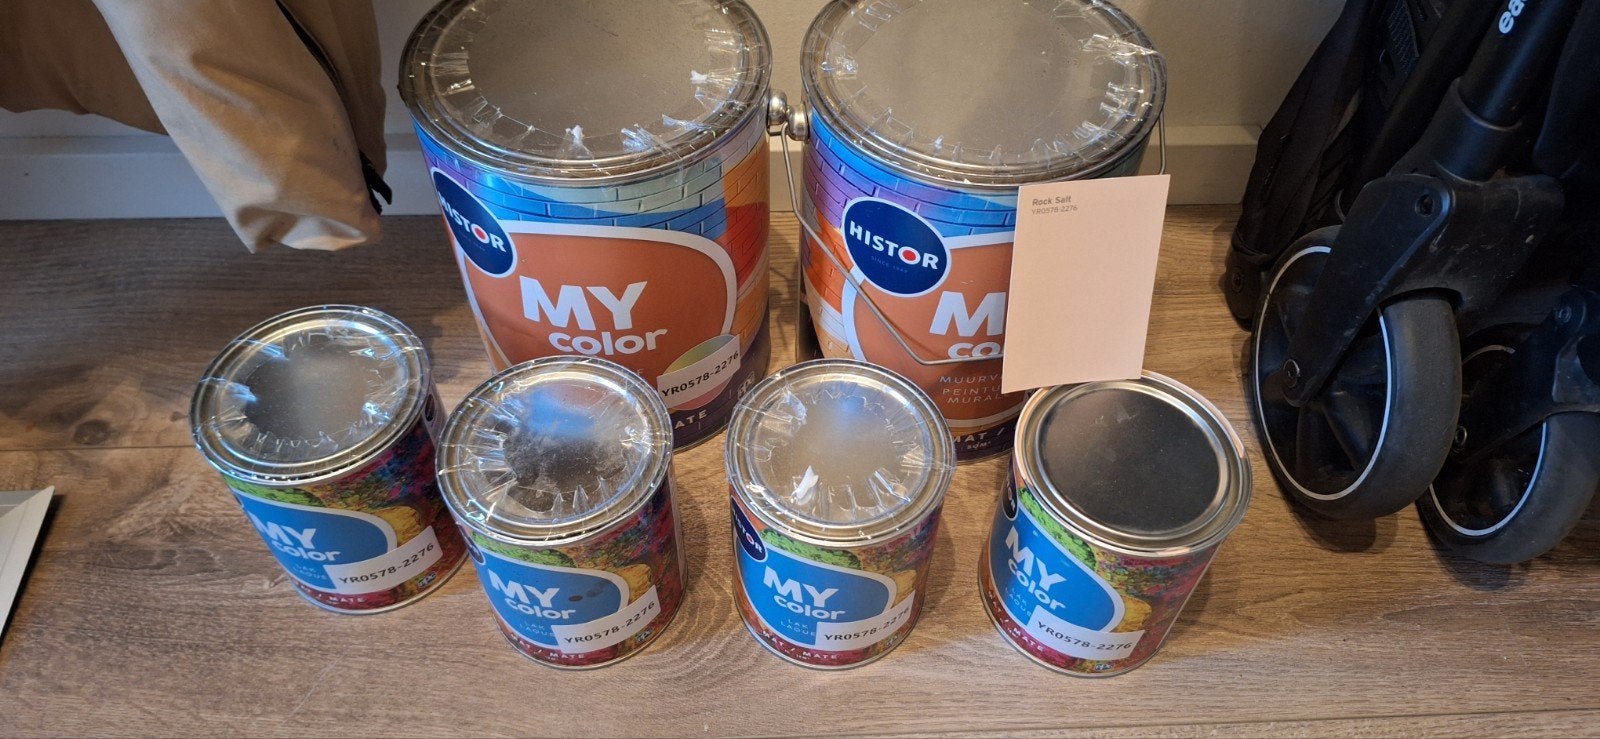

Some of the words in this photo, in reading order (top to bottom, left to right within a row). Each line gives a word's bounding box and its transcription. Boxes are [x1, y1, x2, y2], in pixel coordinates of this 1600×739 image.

[1498, 0, 1527, 34] ea
[1032, 197, 1053, 206] Rock
[1055, 195, 1072, 204] Salt
[436, 191, 507, 253] HISTOR
[849, 220, 939, 270] HISTOR
[519, 275, 648, 331] MY
[929, 290, 1006, 336] M
[548, 328, 668, 356] color
[661, 350, 740, 397] YR0578-2276
[939, 374, 1003, 384] MUURV
[942, 385, 1002, 396] PEINTU
[947, 395, 1003, 404] MURAL
[674, 409, 708, 430] ATE
[245, 511, 317, 549] MY
[271, 540, 341, 562] color
[338, 543, 434, 584] YR0578-2276
[1005, 525, 1068, 592] MY
[488, 569, 560, 608] MY
[763, 566, 840, 608] MY
[1008, 558, 1067, 611] color
[504, 598, 576, 619] color
[563, 601, 655, 644] YR0578-2276
[773, 594, 847, 620] color
[824, 606, 910, 640] YR0578-2276
[1037, 620, 1133, 651] YR0578-2276
[802, 651, 838, 660] MATE
